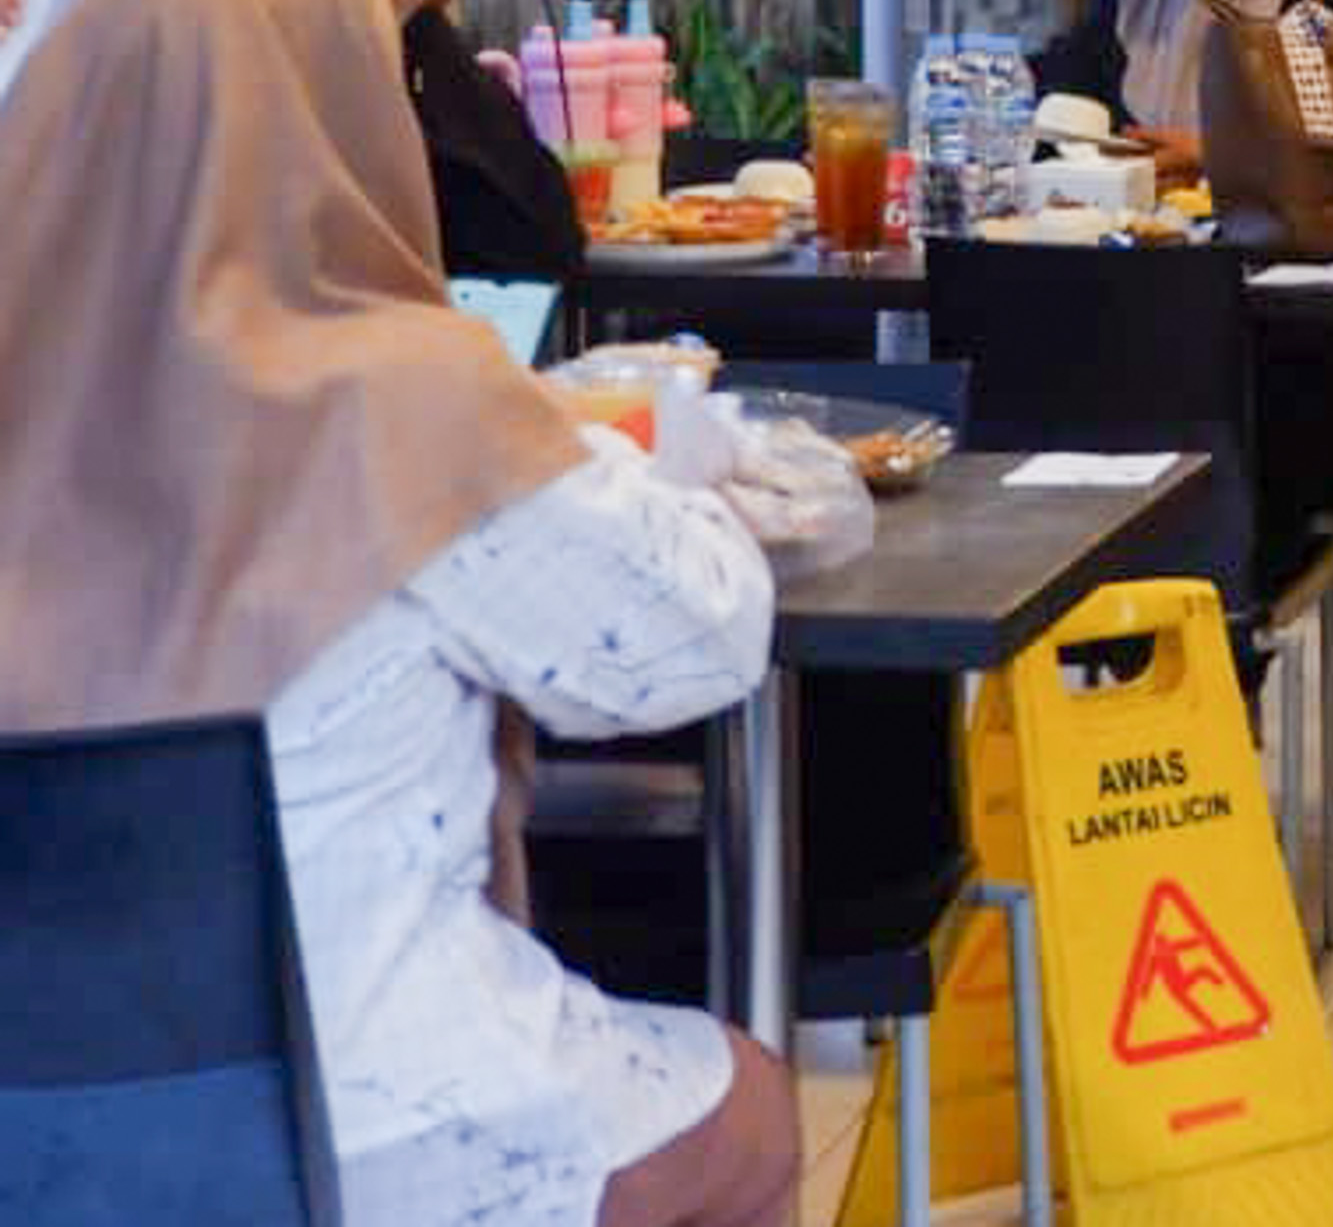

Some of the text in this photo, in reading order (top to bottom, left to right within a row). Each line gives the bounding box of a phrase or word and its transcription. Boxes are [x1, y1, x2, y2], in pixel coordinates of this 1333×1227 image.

[1098, 749, 1187, 799] AWAS
[1068, 791, 1231, 847] LANTAI LICIN
